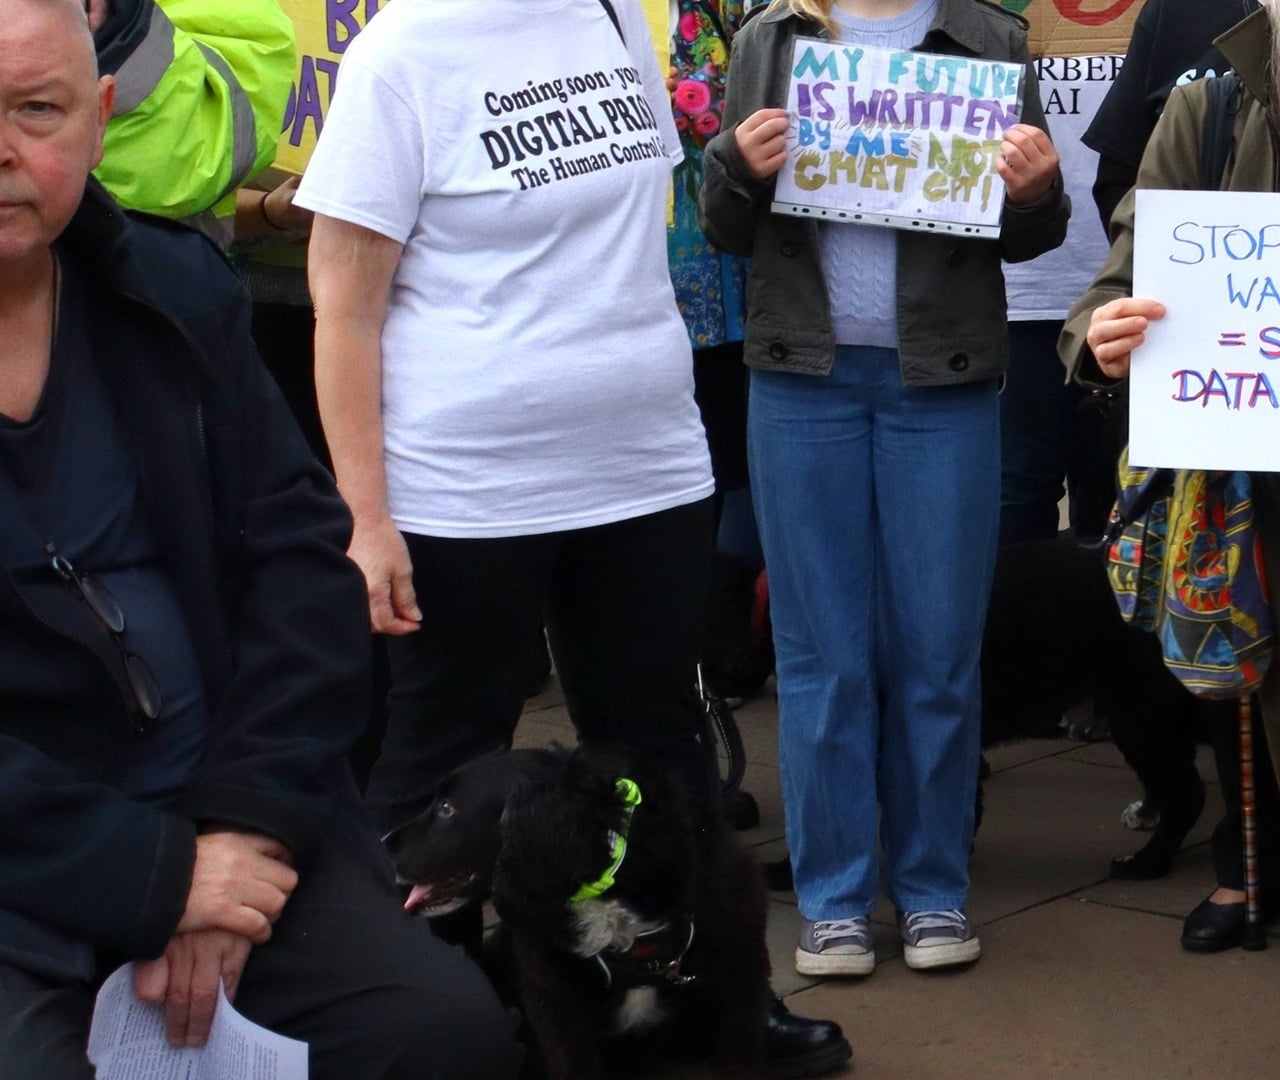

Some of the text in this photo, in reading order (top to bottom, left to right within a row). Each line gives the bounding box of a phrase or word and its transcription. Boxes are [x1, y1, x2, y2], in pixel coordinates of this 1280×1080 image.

[484, 71, 611, 117] Coming soon
[793, 46, 1019, 98] MY FUTURE
[797, 81, 1021, 140] IS WRITTEN
[1044, 88, 1081, 115] AI
[480, 106, 606, 170] DIGITAL
[511, 136, 660, 191] The Human Control
[846, 127, 911, 157] ME
[928, 132, 1003, 177] NOT
[794, 152, 993, 213] CHAT GPT!
[1172, 368, 1280, 412] DATA
